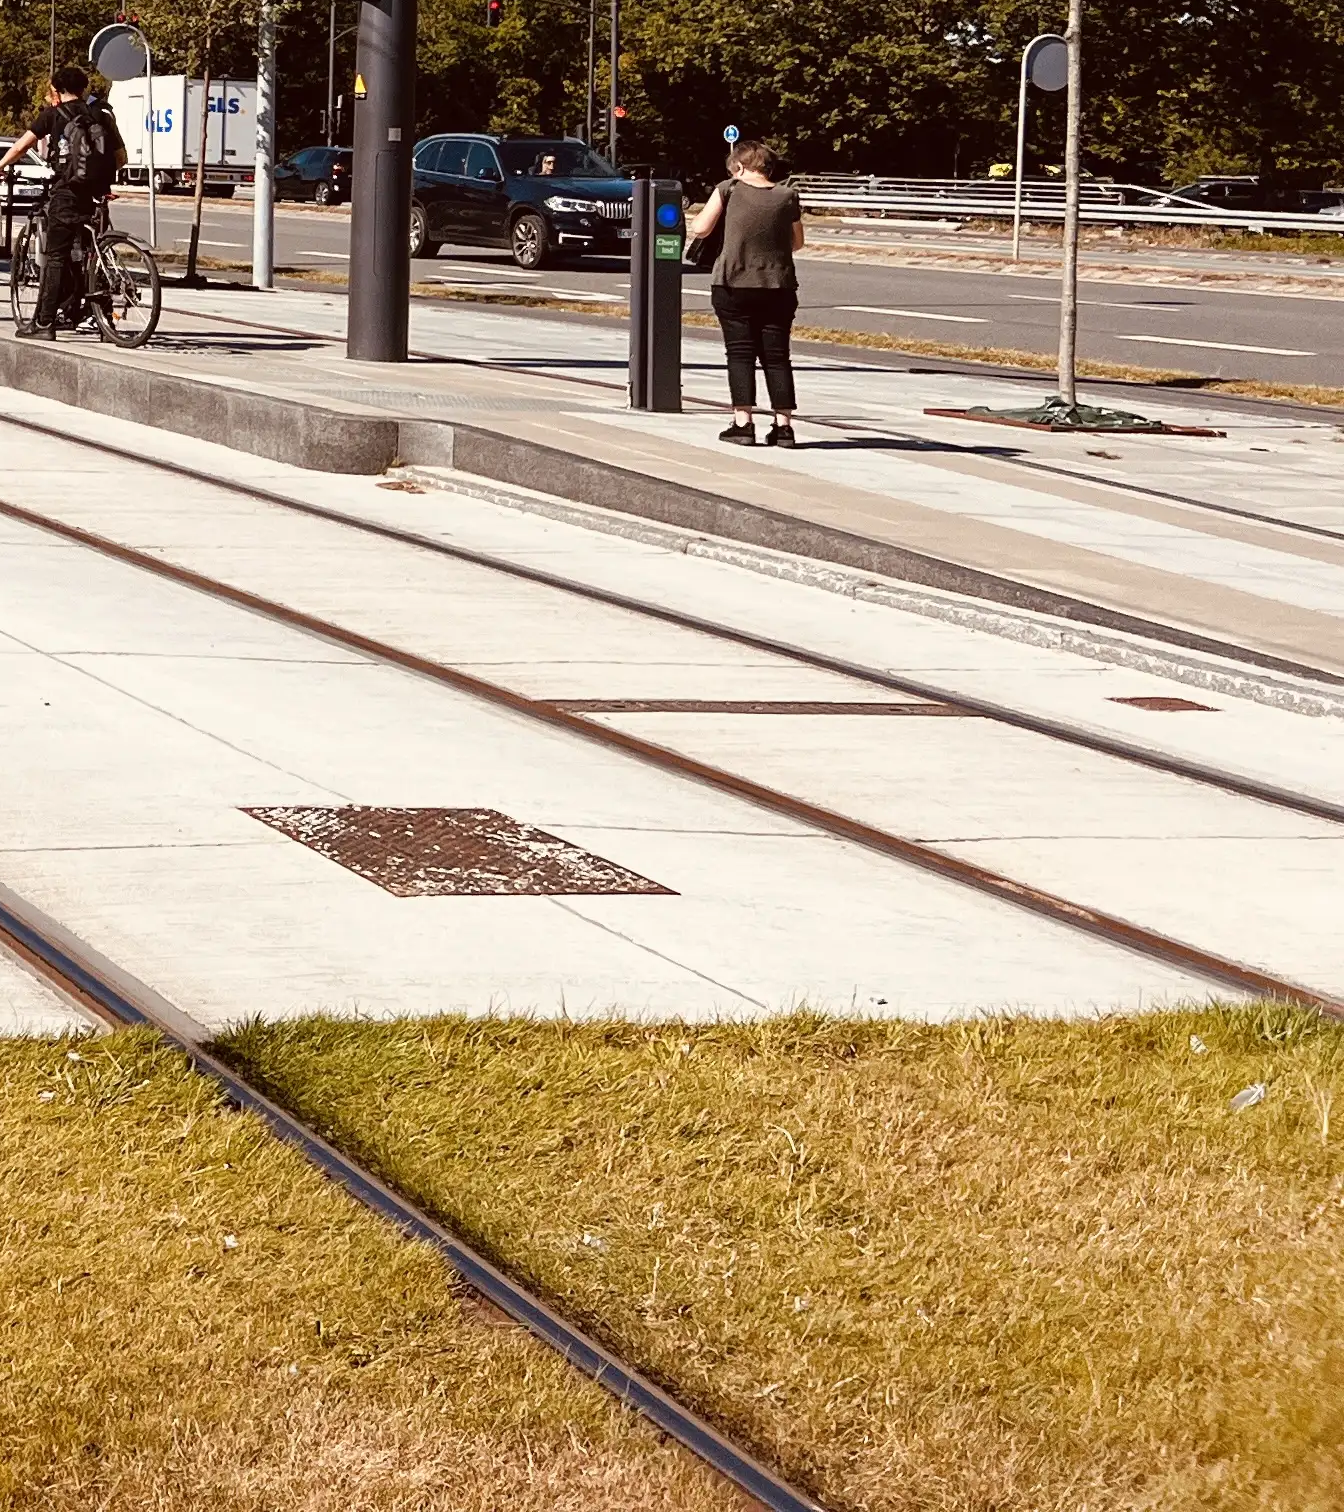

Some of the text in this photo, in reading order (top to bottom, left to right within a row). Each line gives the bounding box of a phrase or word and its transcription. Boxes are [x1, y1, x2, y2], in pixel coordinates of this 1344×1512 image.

[206, 96, 240, 114] GLS
[145, 109, 173, 133] GLS
[656, 238, 679, 247] Check
